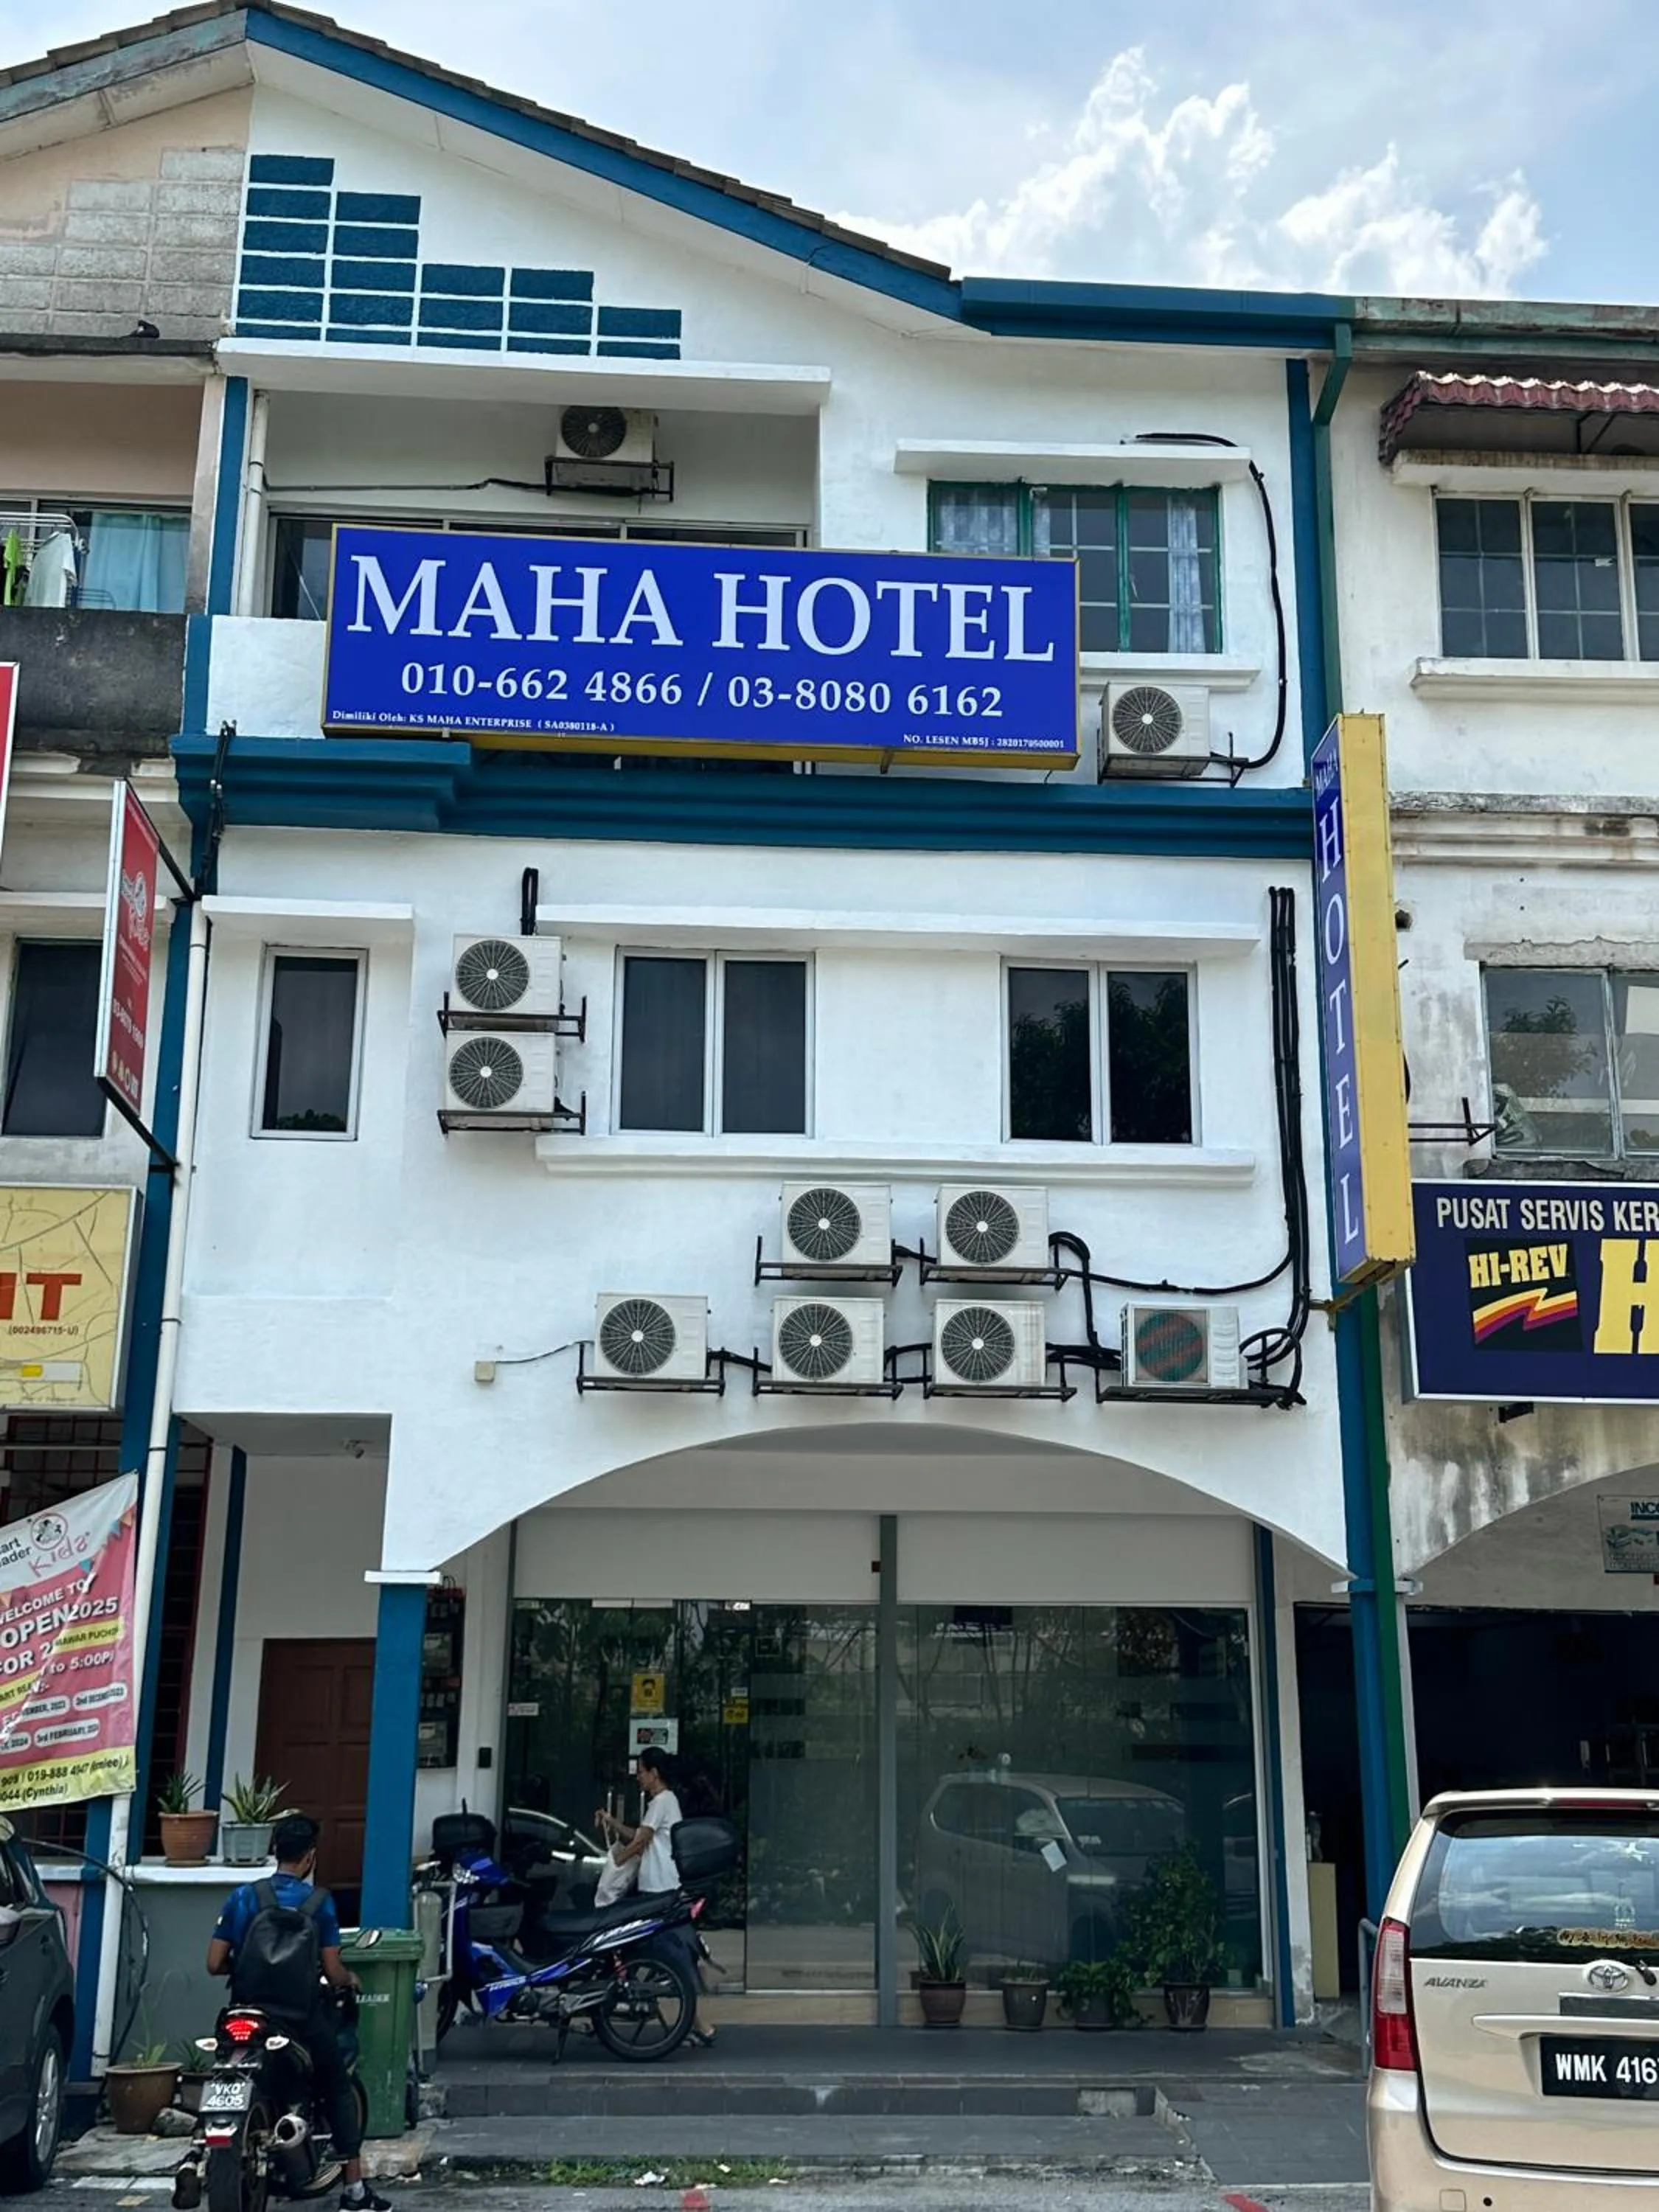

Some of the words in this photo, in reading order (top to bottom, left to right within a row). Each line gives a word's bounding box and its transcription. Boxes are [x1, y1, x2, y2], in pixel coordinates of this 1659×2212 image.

[347, 555, 684, 646] MAHA
[712, 573, 1054, 662] HOTEL
[403, 663, 568, 700] 010-662
[585, 672, 682, 704] 4866
[696, 672, 714, 706] /
[728, 676, 890, 713] 03-8080
[908, 685, 1003, 717] 6162
[333, 710, 377, 720] Dimiliki
[378, 713, 406, 722] Oleh:
[409, 714, 424, 723] KS
[427, 715, 462, 725] MAHA
[465, 717, 532, 728] ENTERPRISE
[903, 734, 922, 743] NO.
[925, 736, 959, 745] LESEN
[962, 737, 989, 747] MBSJ
[1319, 796, 1359, 1245] HOTEL
[1437, 1197, 1511, 1229] PUSAT
[1520, 1199, 1604, 1231] SERVIS
[1613, 1201, 1659, 1232] KER
[1469, 1244, 1568, 1288] HI-REV
[1555, 2053, 1607, 2082] WMK
[1615, 2056, 1659, 2084] 416
